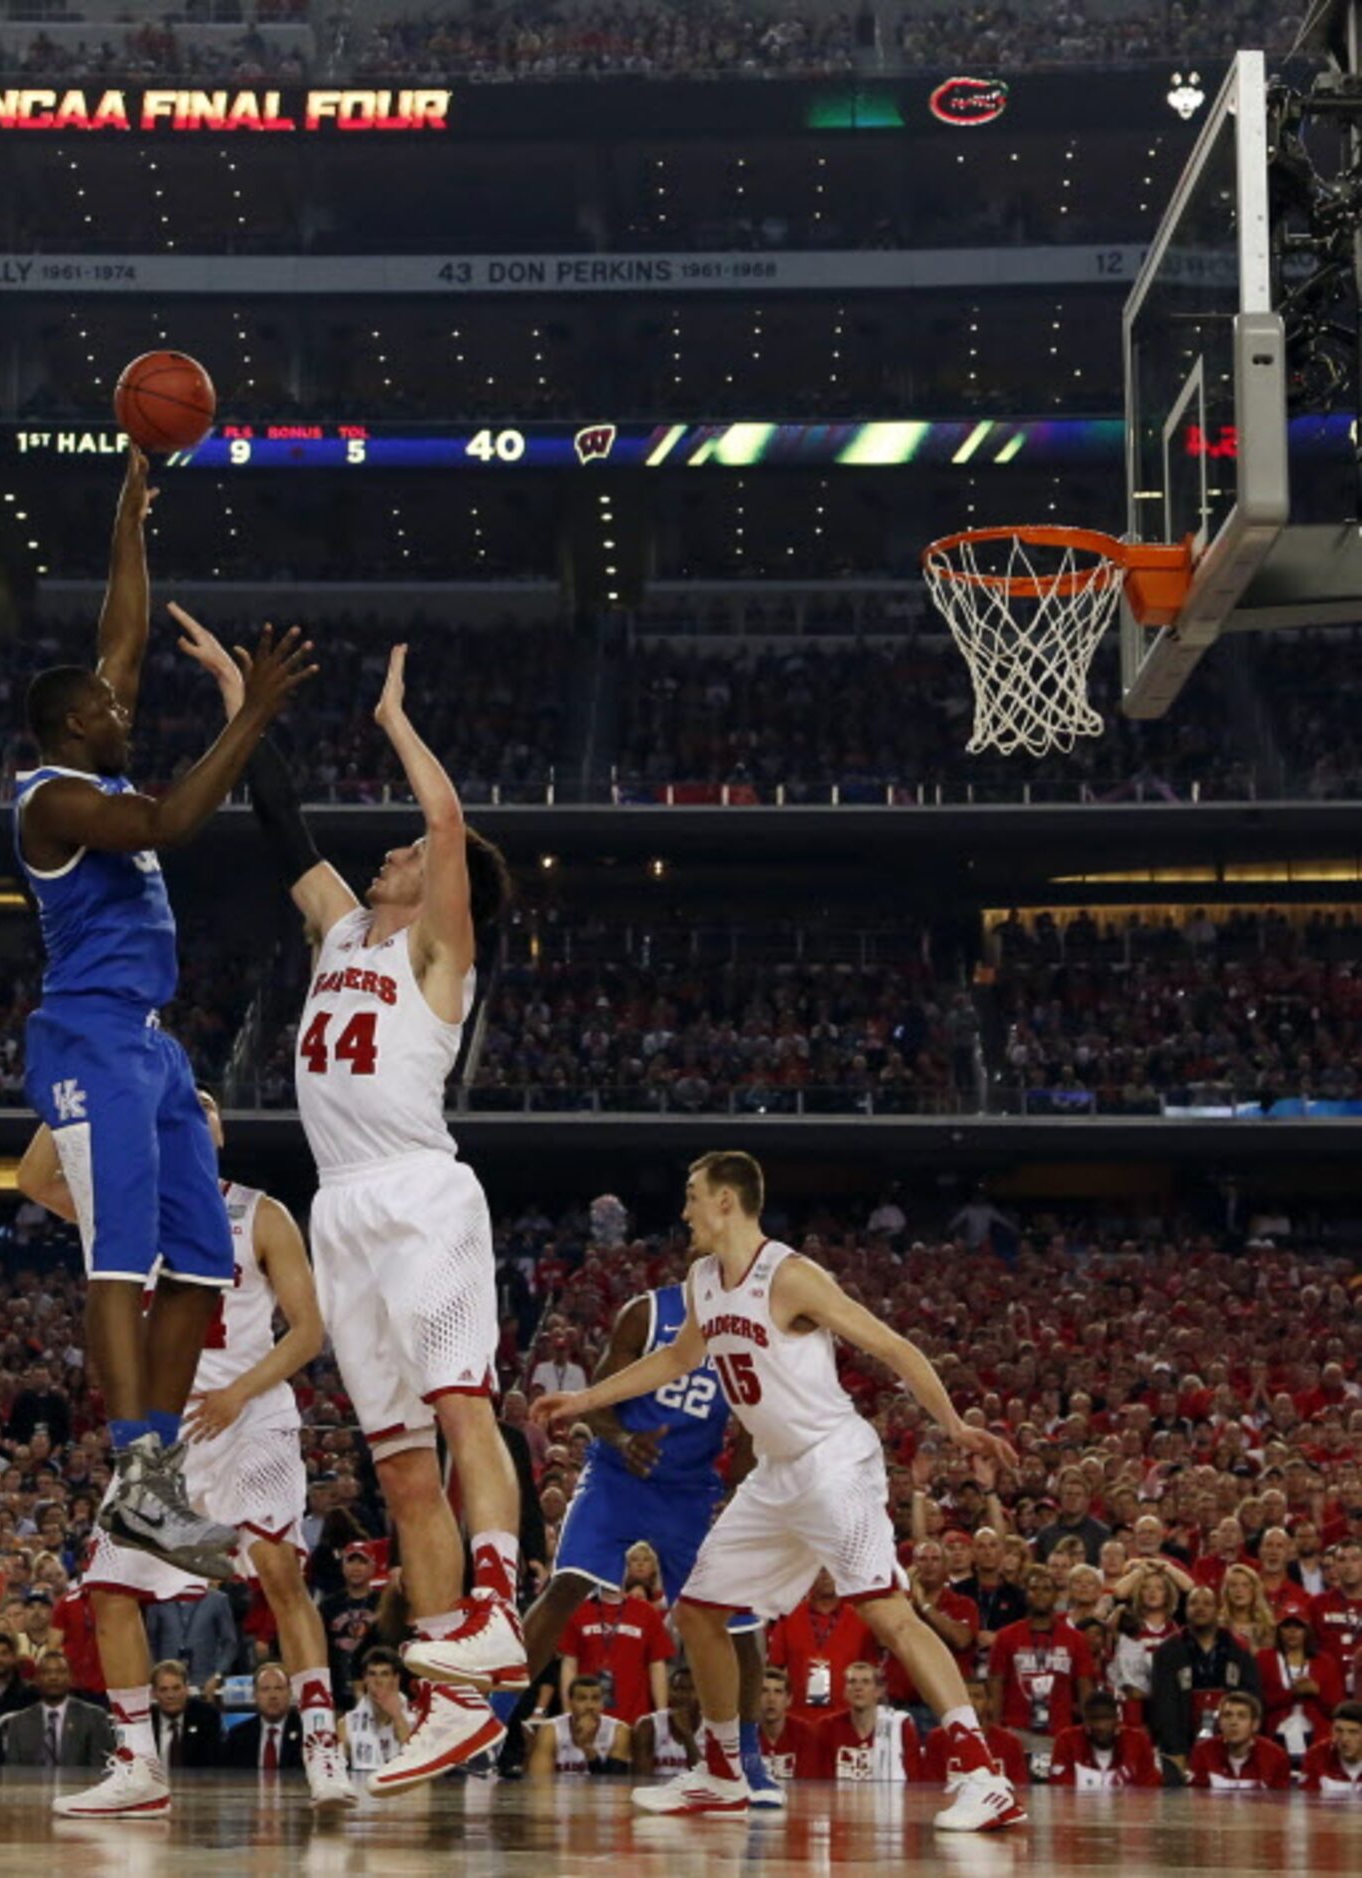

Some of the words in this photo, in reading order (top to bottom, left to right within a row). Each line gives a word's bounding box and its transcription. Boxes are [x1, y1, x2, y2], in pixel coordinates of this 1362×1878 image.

[140, 89, 296, 132] FINAL
[304, 89, 452, 132] FOUR
[438, 261, 473, 284] 43
[488, 260, 546, 284] DON
[556, 259, 673, 283] PERKINS
[1095, 252, 1124, 275] 12
[16, 432, 51, 454] 1ST
[56, 432, 131, 454] HALF
[229, 438, 252, 465] 9
[345, 438, 367, 464] 5
[464, 428, 526, 462] 40
[299, 1010, 379, 1076] 44
[712, 1353, 763, 1406] 15
[654, 1375, 718, 1420] 22
